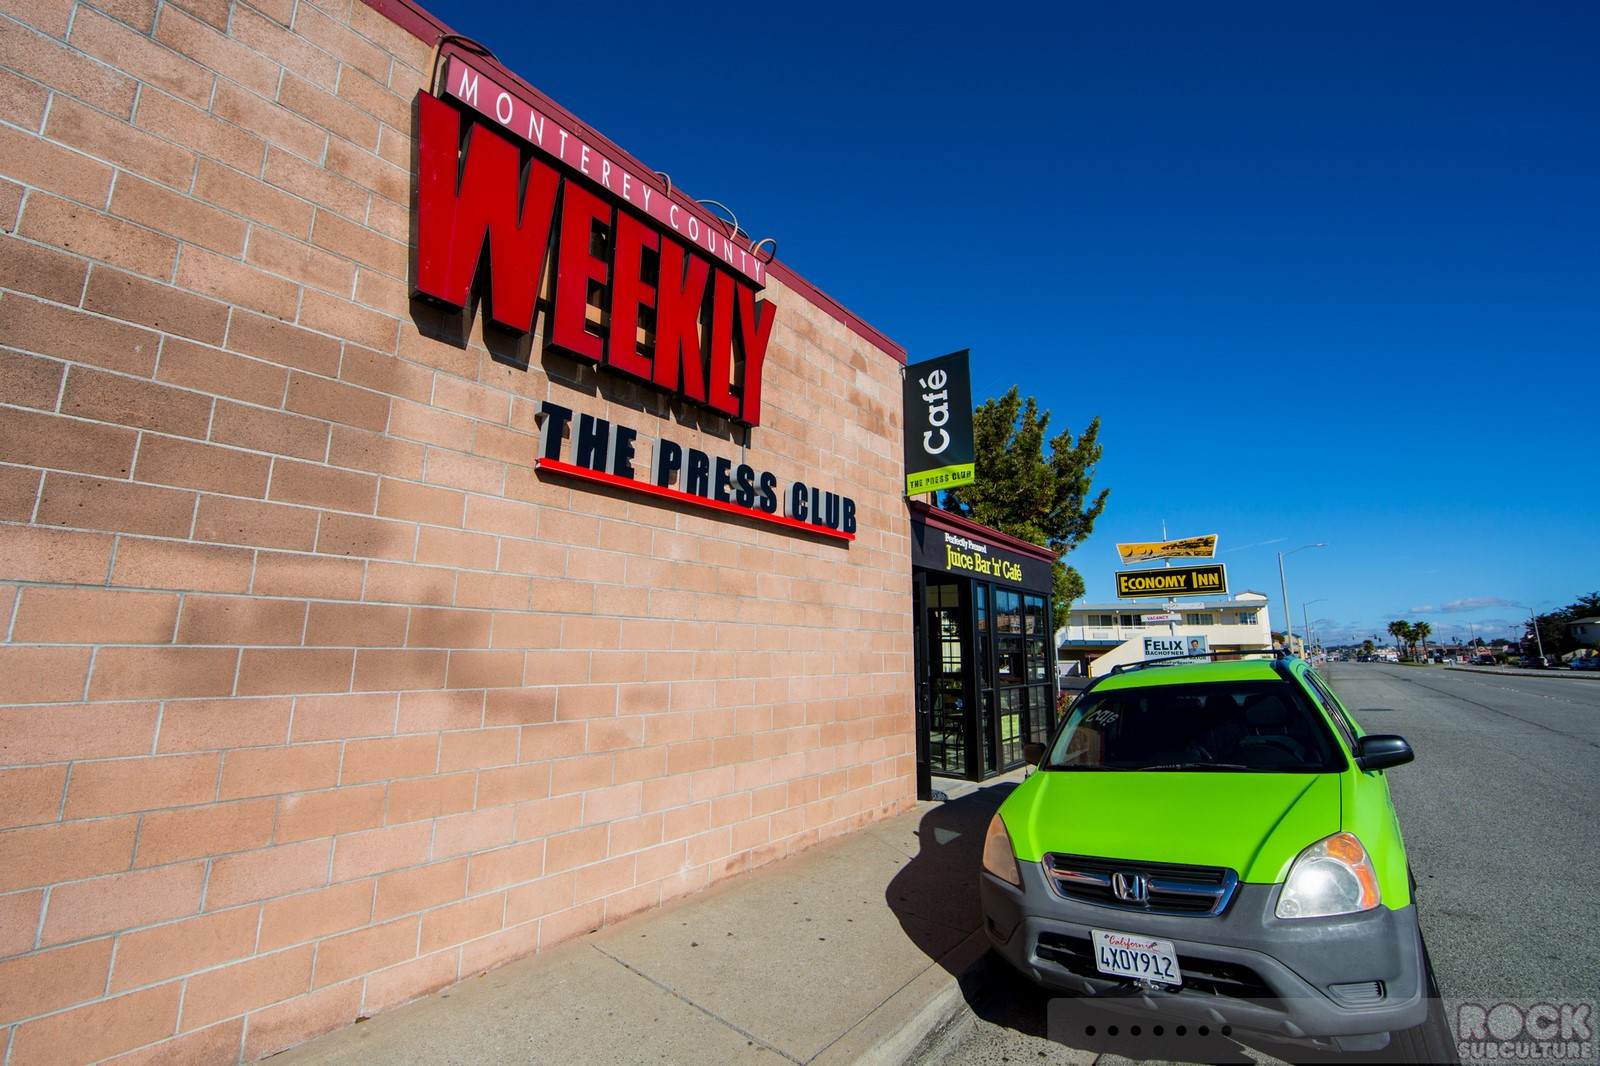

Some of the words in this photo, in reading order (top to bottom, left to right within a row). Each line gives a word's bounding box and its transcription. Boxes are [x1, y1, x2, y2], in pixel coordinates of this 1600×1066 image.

[457, 67, 652, 212] MONTEREY
[669, 204, 763, 283] COUNTY
[411, 88, 777, 428] WEEKLY
[918, 368, 951, 455] Café
[536, 400, 638, 481] THE
[652, 437, 778, 515] PRESS
[785, 481, 857, 534] CLUB
[910, 479, 923, 489] THE
[925, 474, 950, 486] PRESS
[951, 470, 972, 481] CLUB
[946, 544, 973, 570] Juice
[974, 552, 991, 574] Bar
[1002, 560, 1022, 582] Café
[1120, 575, 1187, 593] ECONOMY
[1192, 572, 1219, 589] INN
[1144, 639, 1183, 651] FELIX
[1109, 935, 1160, 952] California
